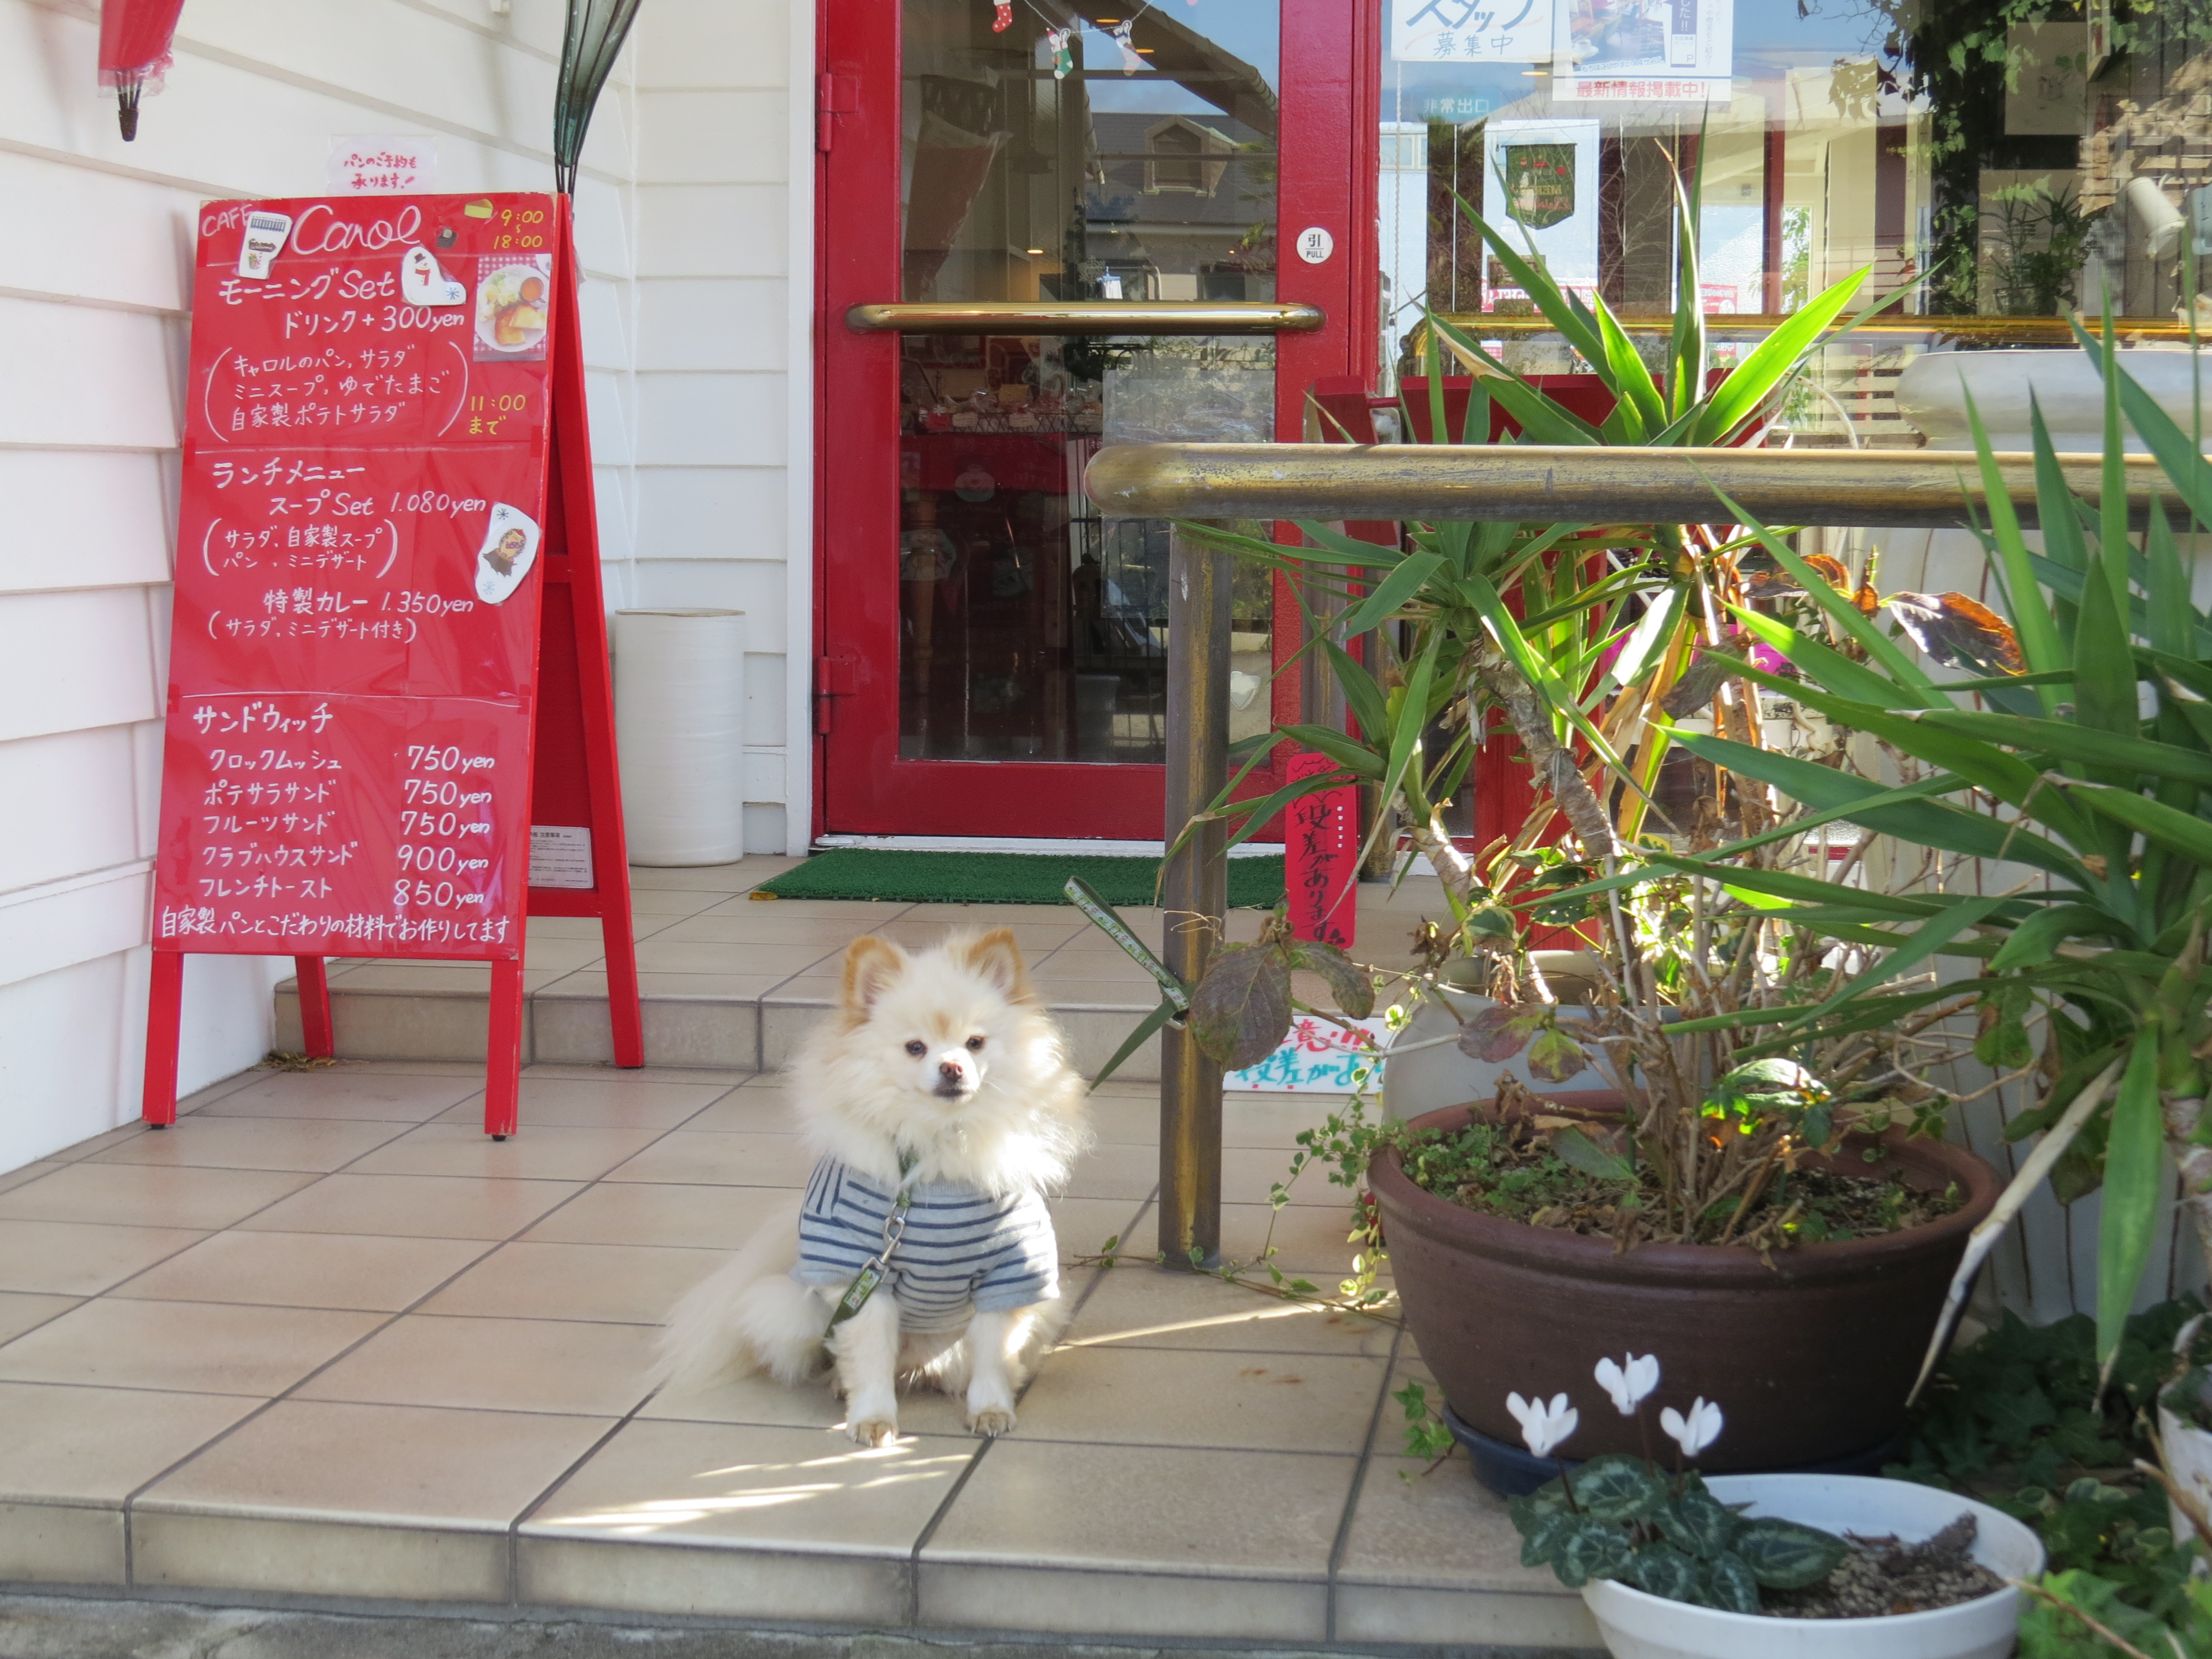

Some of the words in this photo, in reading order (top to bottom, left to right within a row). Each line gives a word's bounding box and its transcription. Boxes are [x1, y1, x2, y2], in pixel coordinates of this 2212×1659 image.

[1433, 31, 1514, 59] 募集中
[1577, 80, 1705, 98] 最新情報掲載中!
[1424, 98, 1489, 113] 非常出口
[344, 152, 416, 168] パンのご予約も
[351, 173, 415, 189] 承ります!
[202, 204, 253, 237] CAFE
[501, 209, 544, 227] 9:00
[493, 234, 542, 249] 18:00
[1308, 234, 1321, 247] 引
[470, 394, 526, 411] 11:00
[232, 401, 406, 431] 自家製ポテトサラダ
[469, 415, 507, 435] まで
[213, 457, 366, 488] ランチメニュー
[263, 588, 368, 614] 特製カレー
[193, 701, 333, 734] サンドウィッチ
[210, 749, 342, 771] クロックムッシュ
[204, 779, 336, 806] ポテサラサンド
[204, 811, 335, 835] フルーツサンド
[202, 841, 358, 867] クラブハウスサンド
[1294, 804, 1338, 941] 段差があります
[199, 875, 332, 899] フレンチトースト
[1282, 1019, 1371, 1051] 意!!
